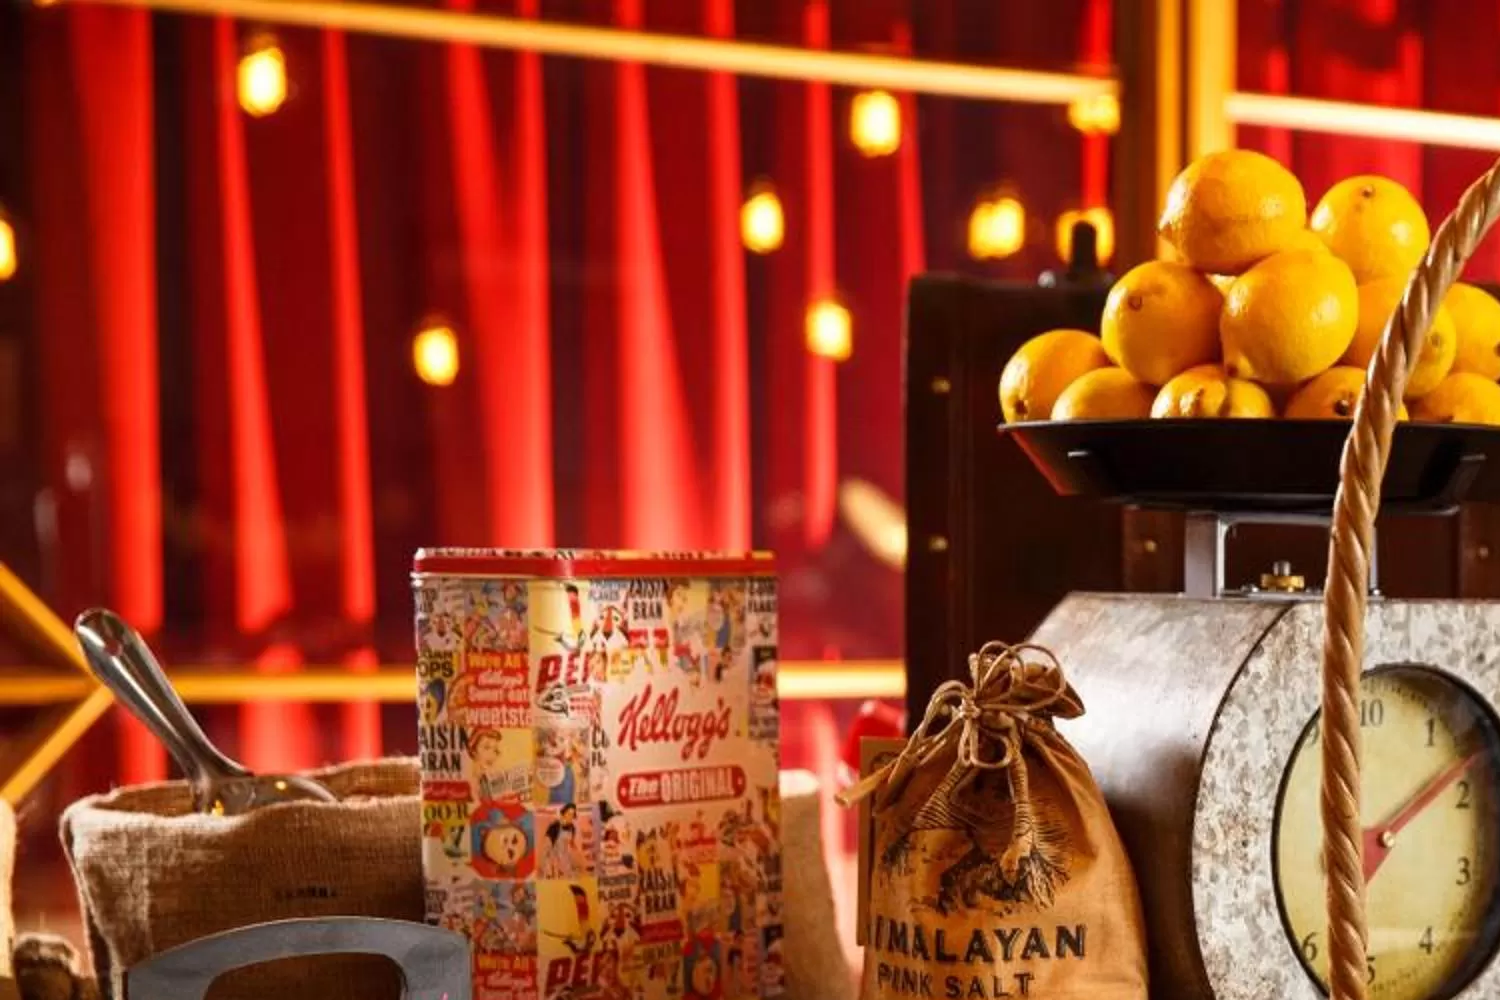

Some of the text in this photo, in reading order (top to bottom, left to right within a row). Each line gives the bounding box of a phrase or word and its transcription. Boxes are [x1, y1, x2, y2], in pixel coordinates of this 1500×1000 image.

[617, 683, 732, 761] Kellogg's
[1360, 699, 1384, 727] 10
[1425, 718, 1437, 747] 1
[661, 766, 734, 803] ORIGINAL
[1456, 782, 1471, 809] 2
[1456, 857, 1471, 886] 3
[1303, 932, 1318, 962] 6
[1418, 926, 1434, 954] 4
[878, 963, 1035, 1000] PINK SALT
